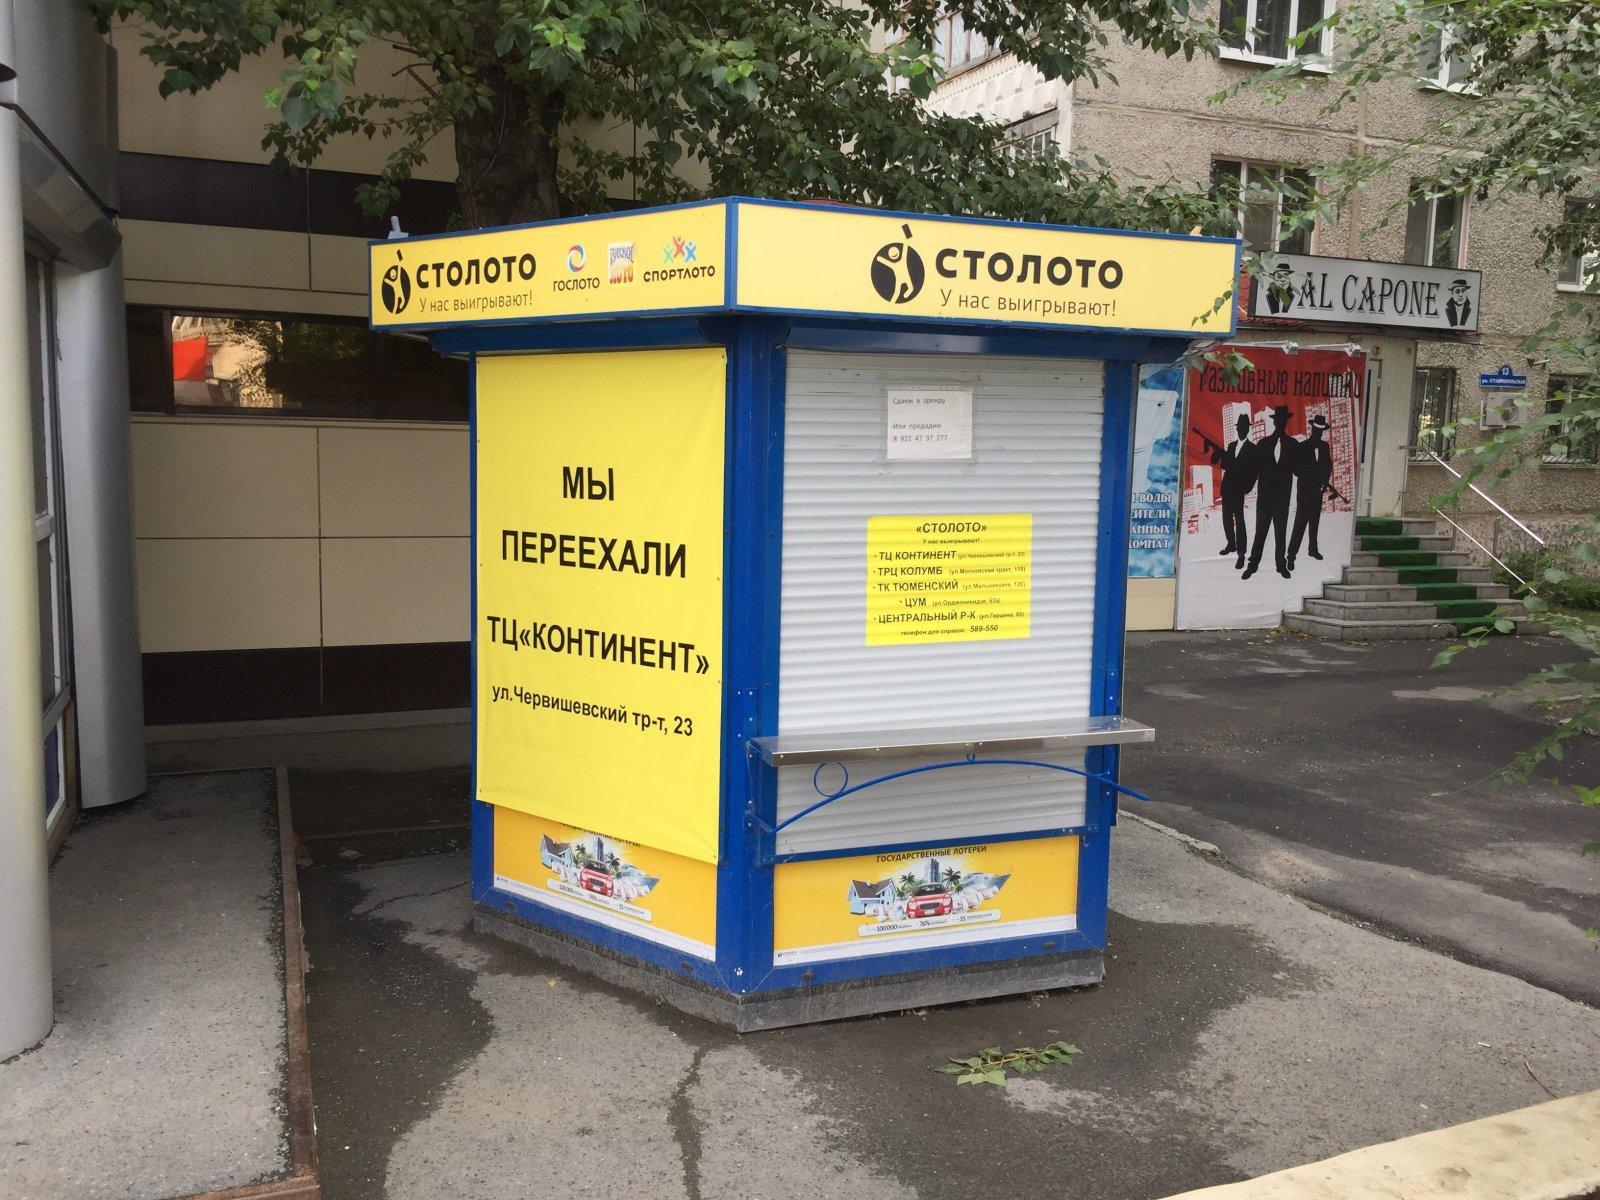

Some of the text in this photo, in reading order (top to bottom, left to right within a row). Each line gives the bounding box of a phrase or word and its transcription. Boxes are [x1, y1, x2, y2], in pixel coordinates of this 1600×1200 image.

[416, 252, 536, 289] СТОЛОТО
[643, 265, 716, 283] СПОРТЛОТО
[935, 247, 1124, 290] СТОЛОТО
[553, 276, 600, 292] ГОСЛОТО
[419, 288, 534, 313] У нас выигрывают!
[940, 288, 1117, 318] У нас выигрывают!
[1296, 271, 1441, 319] AL CAPONE
[1500, 366, 1510, 376] 13
[923, 397, 945, 405] аренду
[908, 423, 942, 431] продадим
[562, 465, 615, 502] МЫ
[1139, 493, 1172, 503] ВОДЫ
[916, 522, 987, 534] «СТОЛОТО»
[502, 529, 686, 579] ПЕРЕЕХАЛИ
[879, 551, 892, 561] ТЦ
[895, 550, 957, 560] КОНТИНЕНТ
[878, 567, 898, 578] ТРЦ
[900, 566, 943, 576] КОЛУМБ
[878, 583, 890, 592] ТК
[893, 579, 959, 592] ТЮМЕНСКИЙ
[905, 597, 927, 608] ЦУМ
[878, 610, 958, 624] ЦЕНТРАЛЬНЫЙ
[960, 610, 976, 619] Р-К
[970, 624, 998, 633] 589-550
[486, 615, 710, 675] ТЦ«КОНТИНЕНТ»
[492, 685, 693, 737] ул.Червишевский тр-т, 23
[876, 844, 987, 863] ГОСУДАРСТВЕННЫЕ ЛОТЕРЕИ
